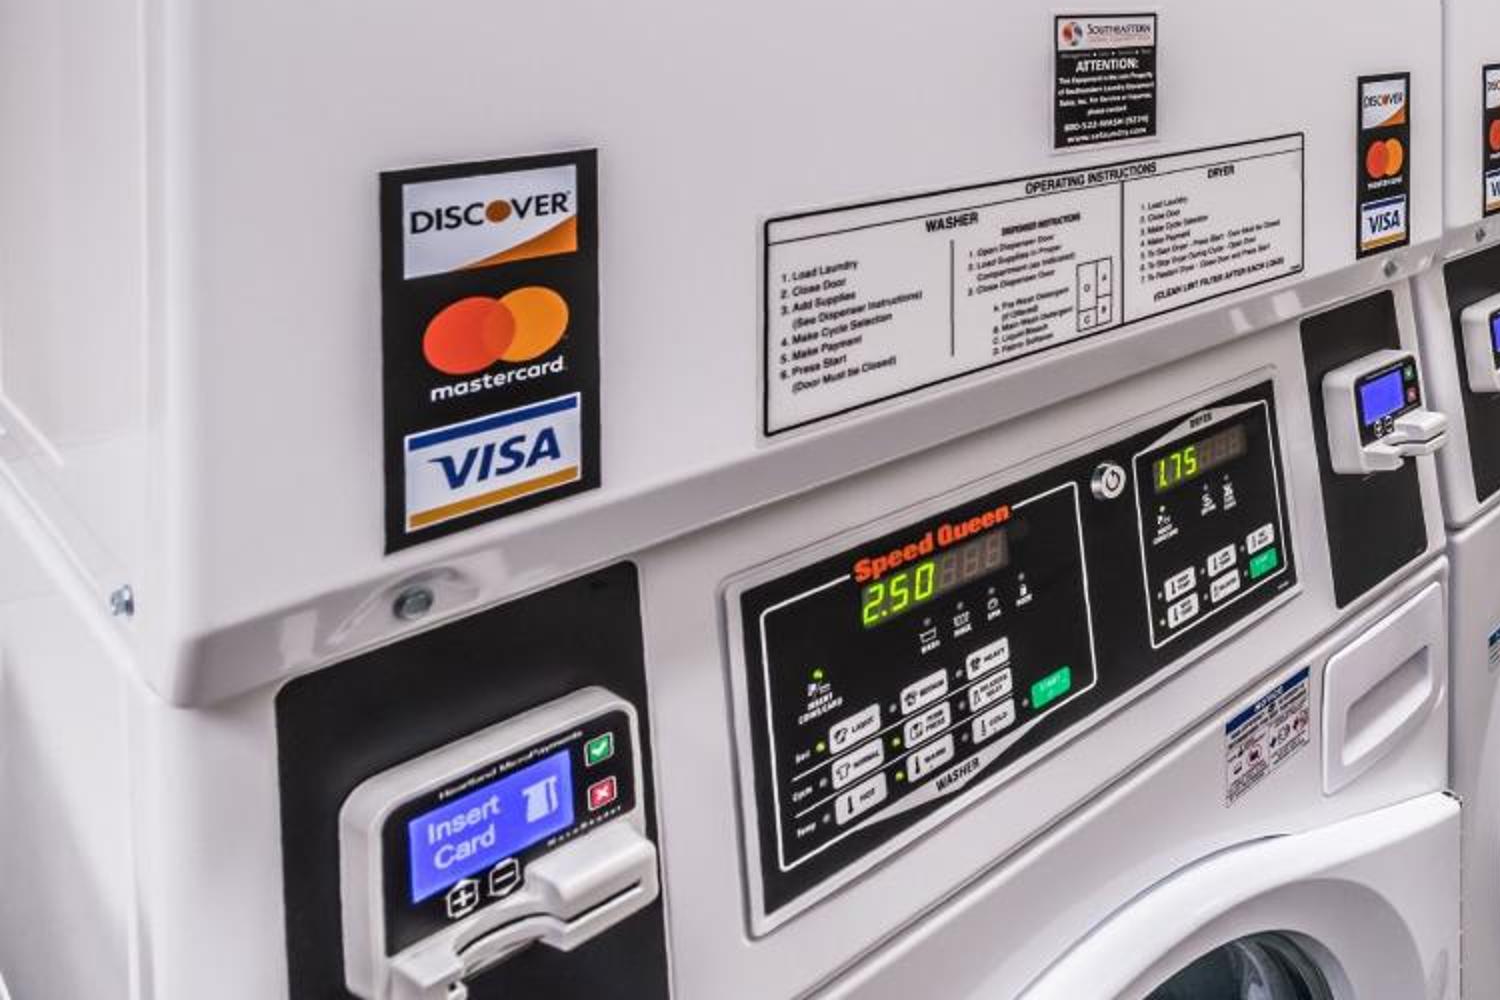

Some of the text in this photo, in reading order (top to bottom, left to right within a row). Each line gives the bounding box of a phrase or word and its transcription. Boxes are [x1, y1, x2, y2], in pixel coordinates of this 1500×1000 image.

[1087, 23, 1151, 34] SOUTHEASTERN
[1075, 57, 1139, 72] ATTENTION:
[1025, 161, 1157, 194] OPERATING INSTRUCTIONS
[1207, 166, 1234, 177] DRYER
[410, 191, 571, 235] DISCOVER
[925, 212, 979, 233] WASHER
[1368, 209, 1401, 234] VISA
[792, 267, 816, 281] Load
[819, 260, 857, 275] Laundry
[792, 283, 819, 295] Close
[823, 275, 846, 290] Door
[793, 299, 812, 313] Add
[815, 290, 855, 307] Supplies
[819, 304, 865, 322] Dispenser
[792, 329, 818, 345] Make
[821, 322, 847, 339] Cycle
[850, 312, 892, 328] Selection
[792, 345, 818, 361] Make
[792, 362, 819, 375] Press
[823, 352, 846, 369] Start
[429, 355, 564, 402] mastercard
[822, 368, 845, 384] Must
[428, 426, 562, 490] VISA
[852, 504, 1011, 582] Speed Queen
[863, 561, 936, 626] 2.50
[935, 757, 980, 792] WASHER
[427, 794, 501, 845] Insert
[433, 824, 496, 870] Card
